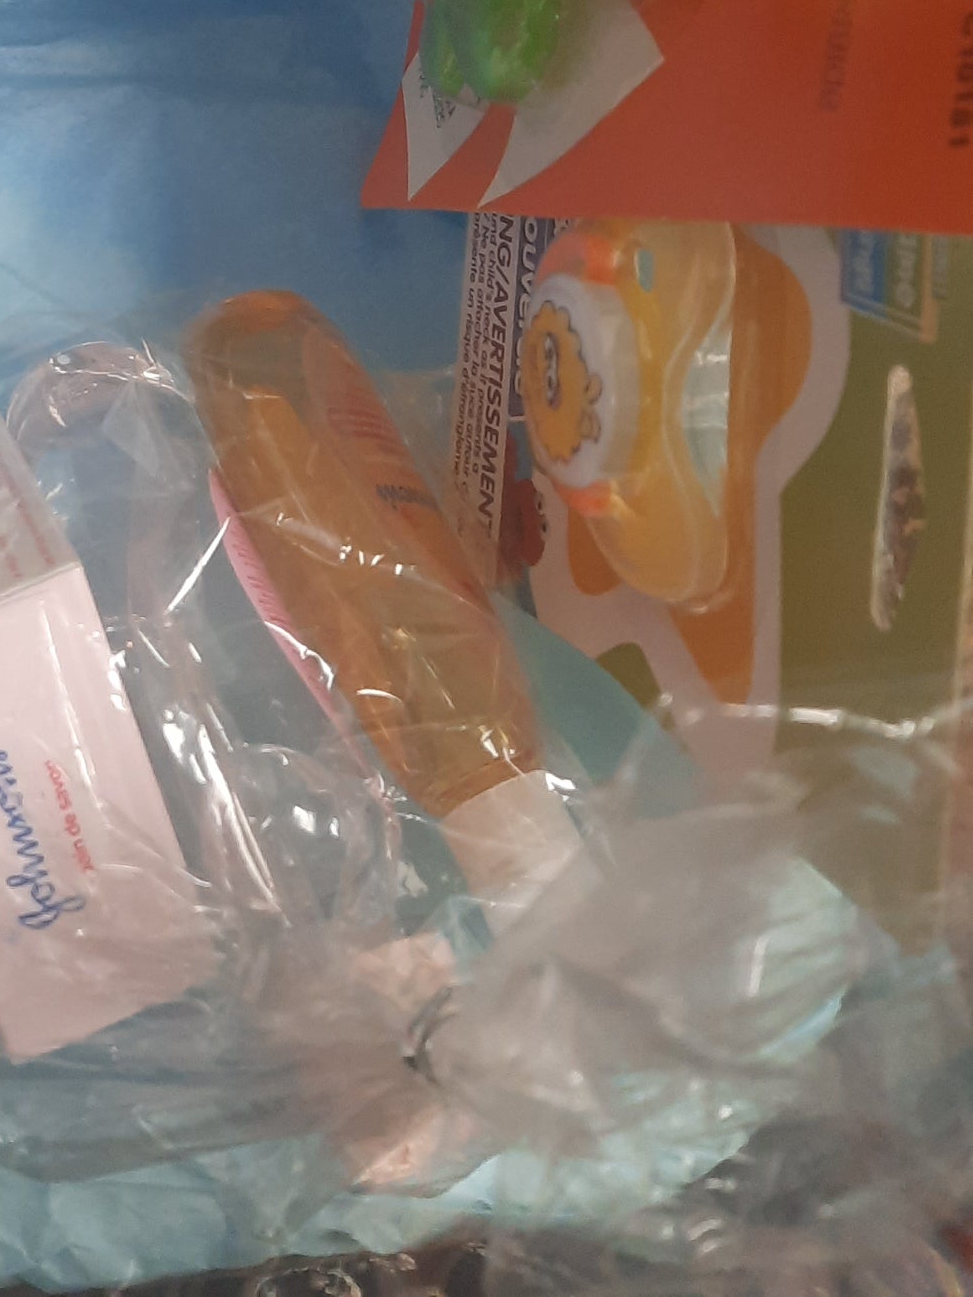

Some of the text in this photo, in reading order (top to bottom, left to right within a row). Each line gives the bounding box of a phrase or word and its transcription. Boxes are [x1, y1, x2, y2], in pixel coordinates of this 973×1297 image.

[479, 225, 490, 247] Ne
[475, 254, 486, 284] pas
[461, 314, 474, 363] risque
[471, 288, 486, 357] attacher
[482, 306, 494, 347] neck
[473, 389, 487, 458] presents
[463, 424, 476, 478] autour
